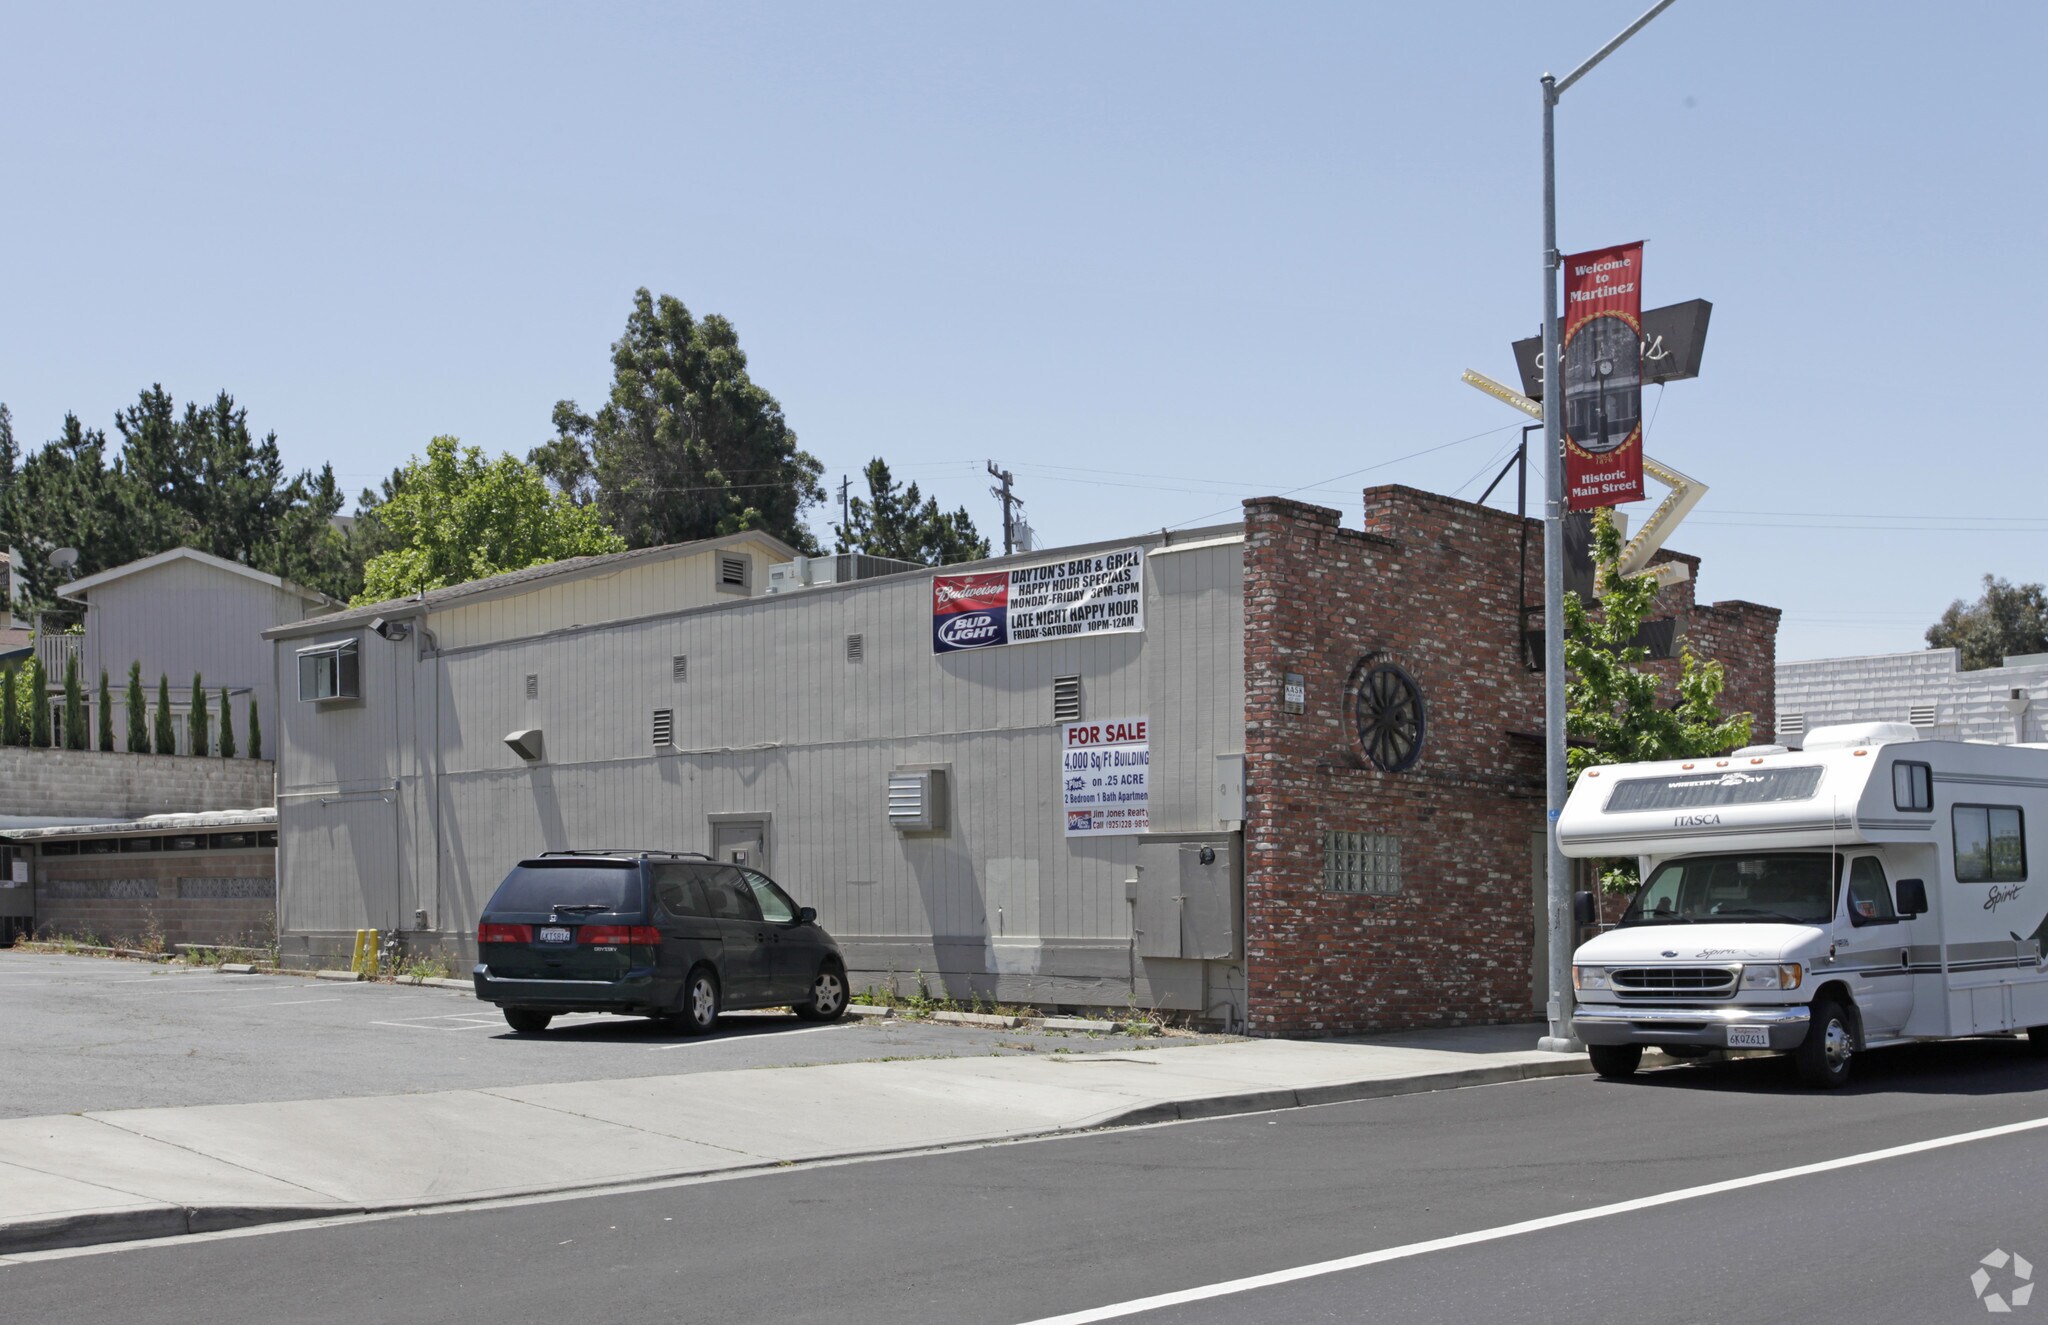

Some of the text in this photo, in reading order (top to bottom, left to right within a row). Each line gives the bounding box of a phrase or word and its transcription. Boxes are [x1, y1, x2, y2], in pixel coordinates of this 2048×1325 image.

[1575, 258, 1631, 276] Welcome
[1596, 274, 1609, 284] to
[1570, 282, 1634, 303] Martinez
[1582, 470, 1626, 484] Historic
[1572, 480, 1637, 498] Main Street
[1011, 551, 1140, 584] DAYTON'S BAR & GRILL
[1018, 569, 1131, 596] HAPPY HOUR SPECIALS
[935, 582, 1006, 603] Budweiser
[1010, 582, 1140, 610] MONDAY-FRIDAY 3PM-6PM
[954, 616, 992, 630] BUD
[1011, 599, 1139, 629] LATE NIGHT HAPPY HOUR
[946, 626, 998, 640] LIGHT
[1013, 616, 1135, 640] FRIDAY-SATURDAY 10PM-12AM
[1068, 722, 1146, 745] FOR SALE
[1064, 752, 1088, 770] 4,000
[1090, 752, 1112, 771] Sq/Ft
[1092, 778, 1102, 786] on
[1104, 776, 1118, 786] .25
[1121, 774, 1144, 785] ACRE
[1065, 794, 1068, 804] 2
[1070, 794, 1095, 803] Bedroom
[1102, 792, 1116, 802] Bath
[1093, 810, 1104, 818] Jim
[1106, 809, 1124, 818] Jones
[1674, 814, 1720, 827] ITASCA
[1093, 821, 1104, 829] Call
[1984, 884, 2025, 913] Spirit
